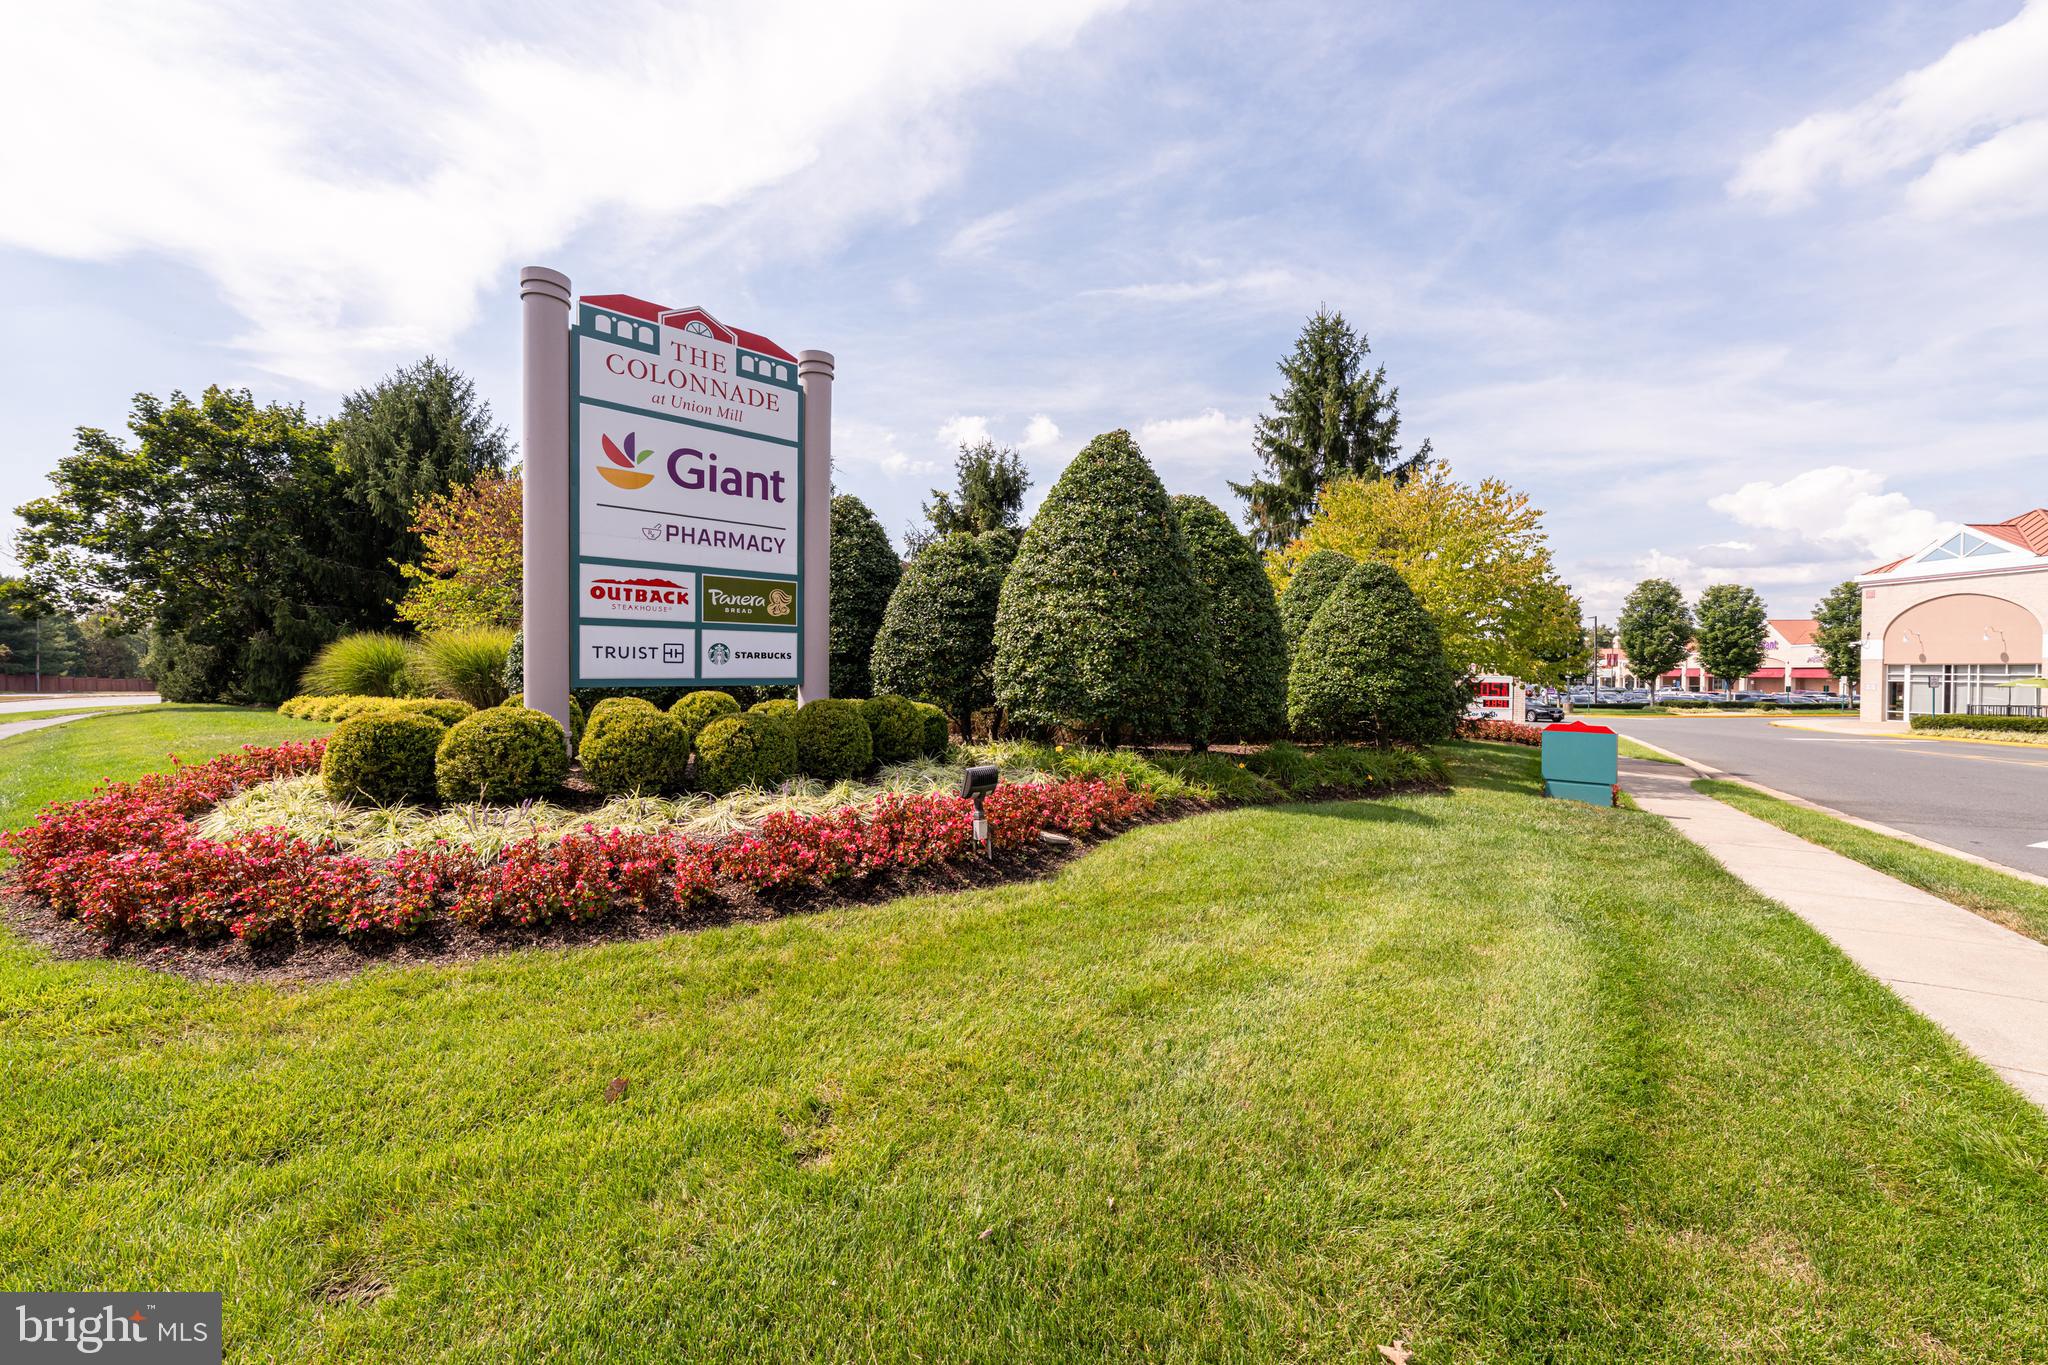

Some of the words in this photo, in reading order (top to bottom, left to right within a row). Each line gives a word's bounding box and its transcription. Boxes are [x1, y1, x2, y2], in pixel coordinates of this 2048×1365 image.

[671, 341, 727, 373] THE
[606, 353, 780, 412] COLONNADE
[651, 393, 665, 405] at
[671, 394, 712, 416] Union
[716, 405, 744, 423] Mill
[666, 448, 786, 504] Giant
[666, 524, 786, 554] PHARMACY
[590, 585, 689, 606] OUTBACK
[708, 588, 766, 607] Panera
[592, 645, 659, 660] TRUIST
[734, 651, 792, 660] STARBUCKS
